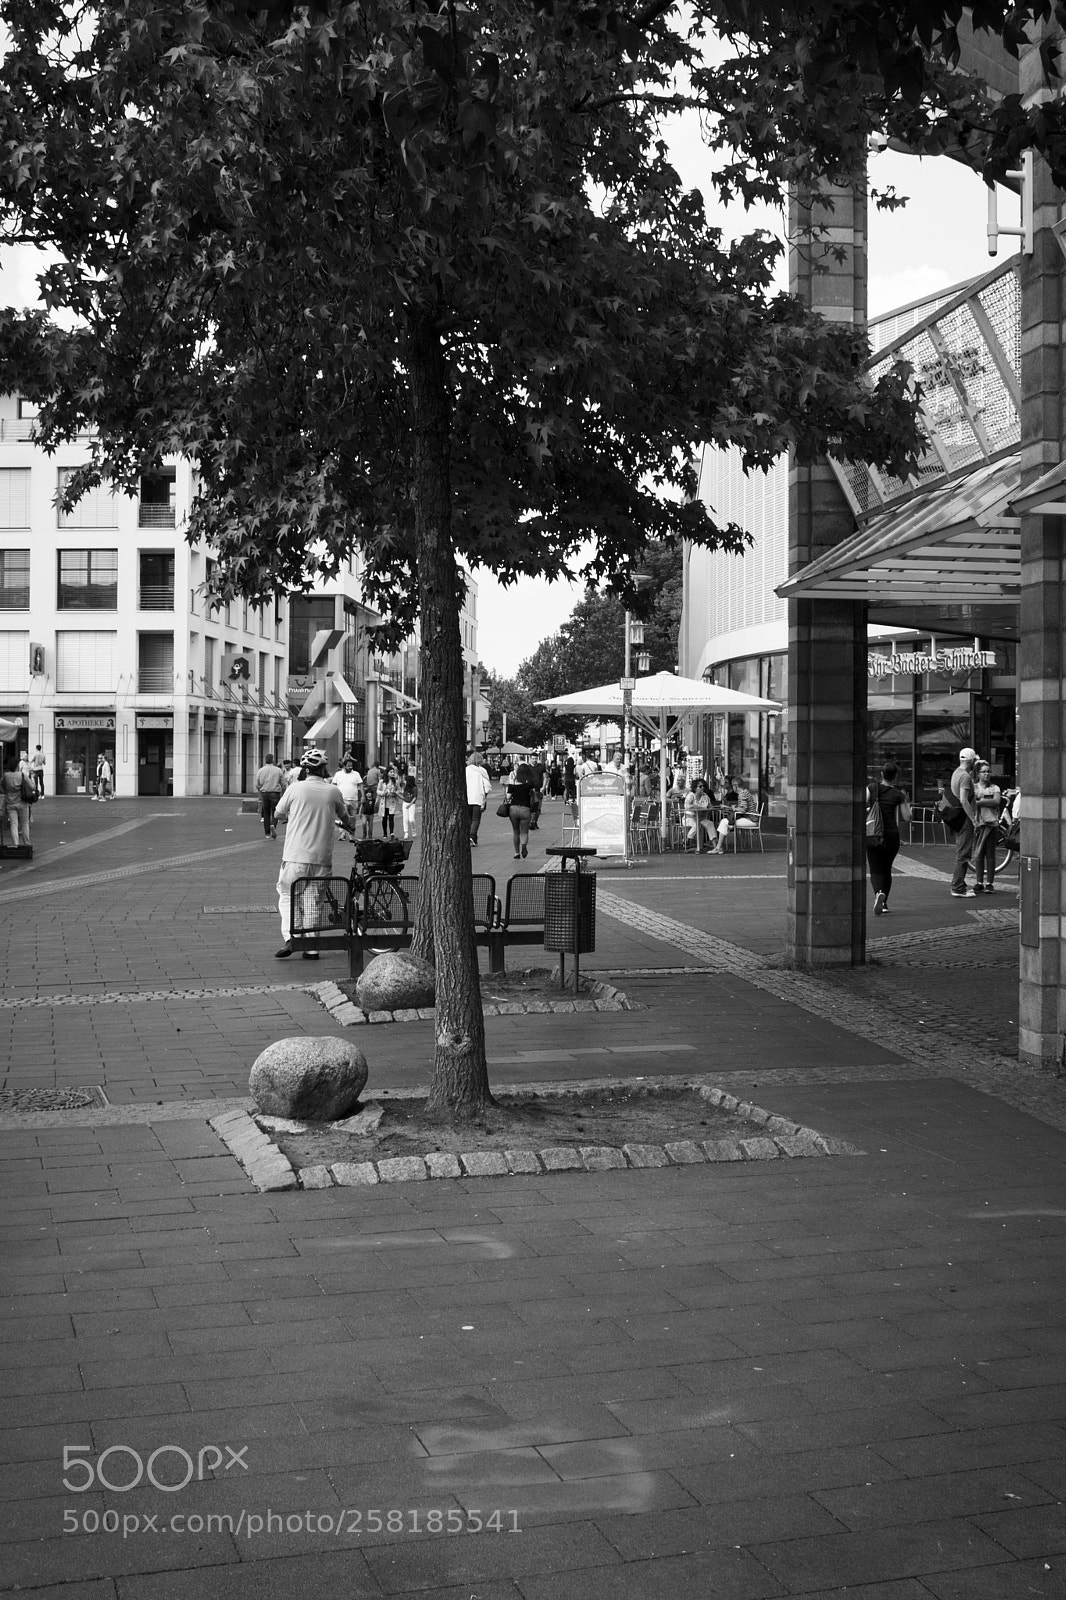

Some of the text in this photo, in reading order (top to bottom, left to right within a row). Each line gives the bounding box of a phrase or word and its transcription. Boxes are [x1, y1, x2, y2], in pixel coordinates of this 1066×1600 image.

[890, 653, 933, 677] Bäcker
[935, 648, 988, 676] Schüren
[66, 719, 105, 727] APOTHEKE
